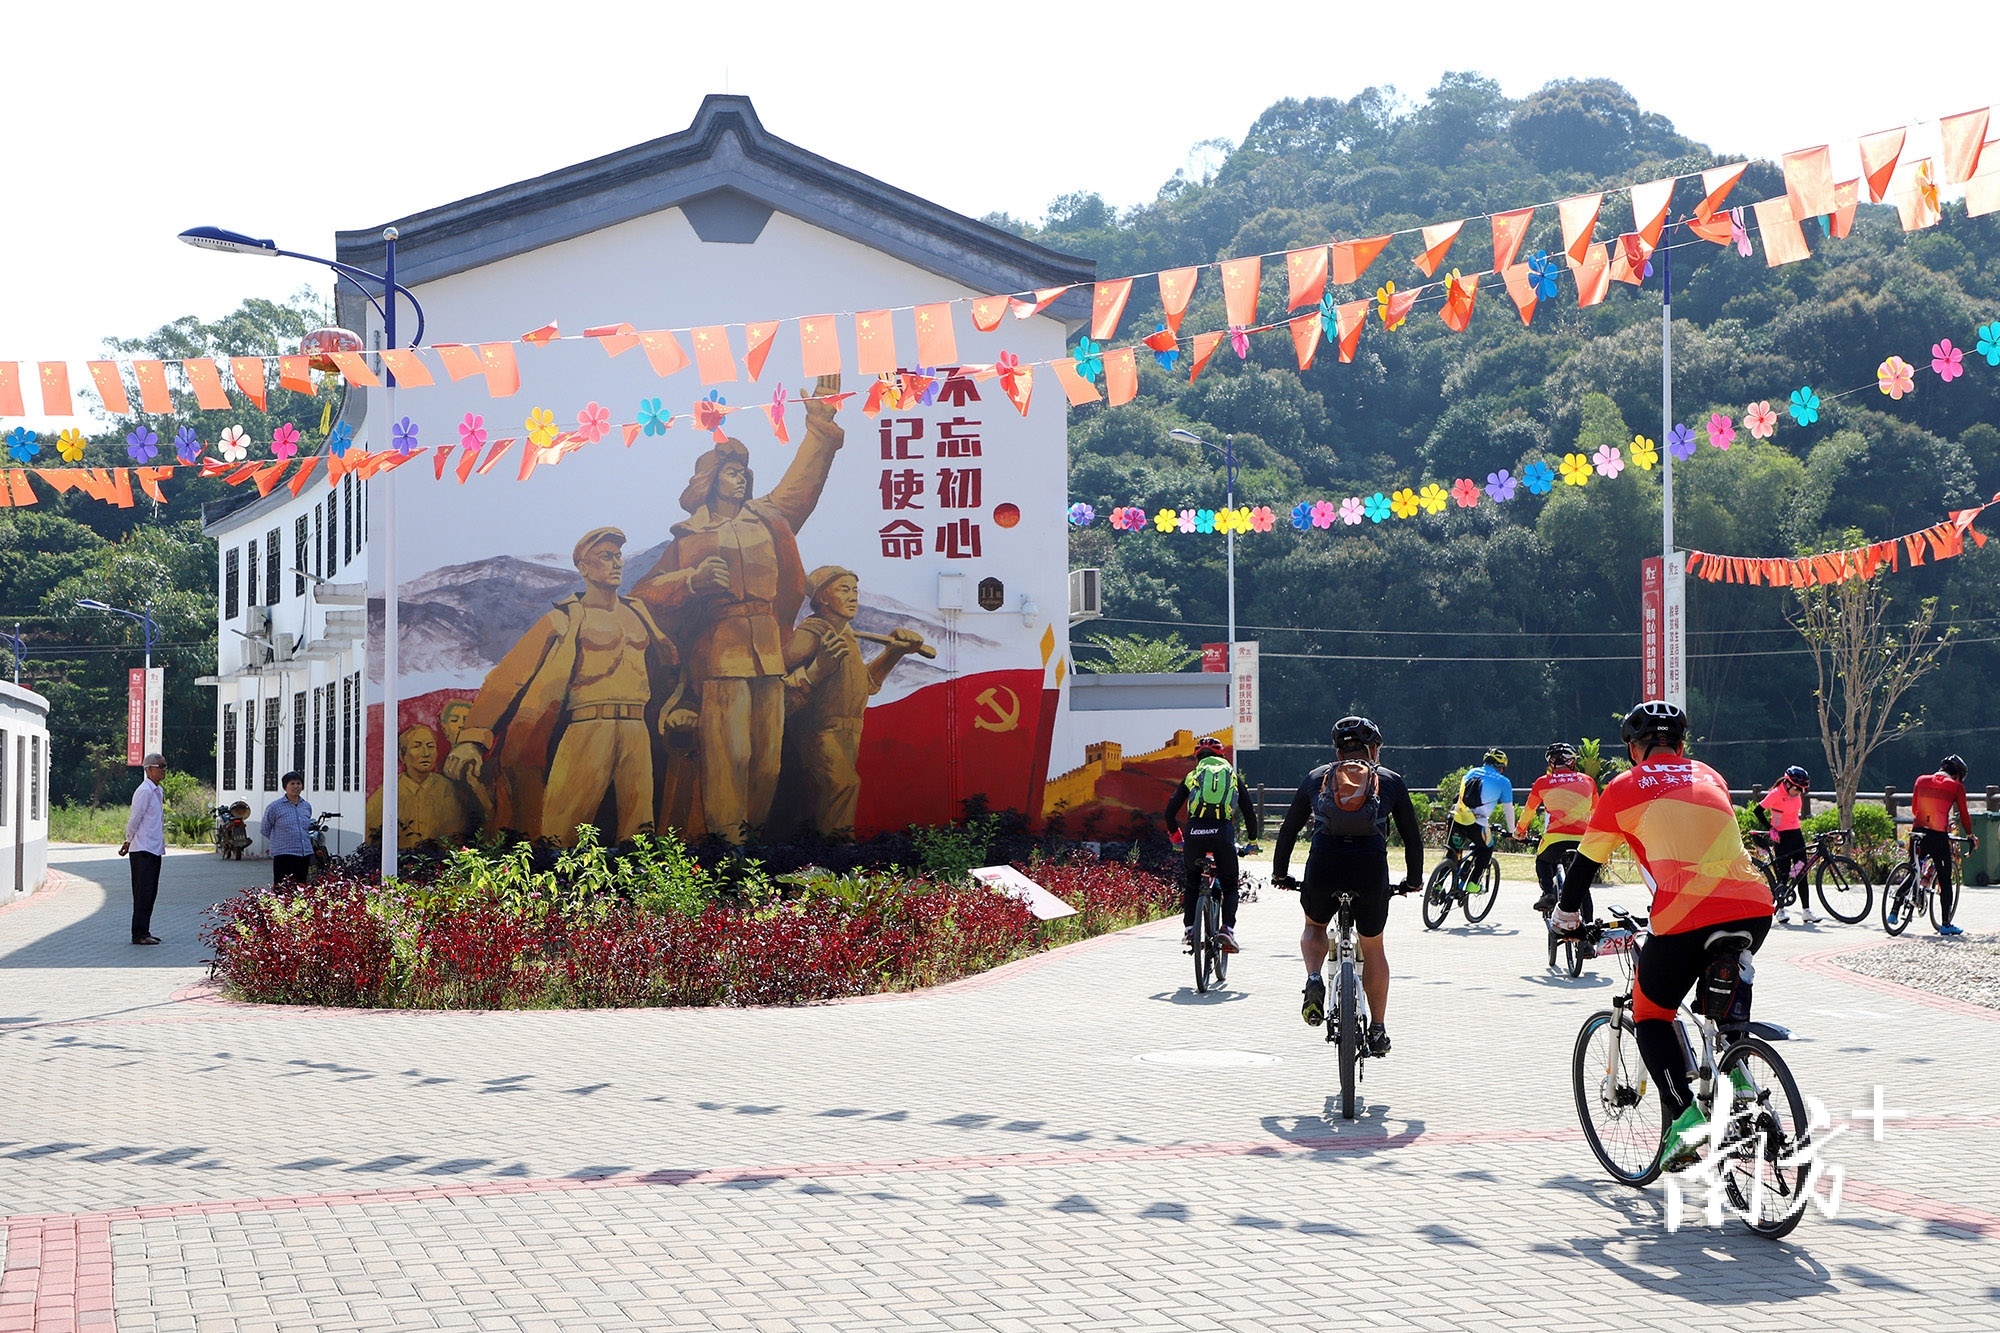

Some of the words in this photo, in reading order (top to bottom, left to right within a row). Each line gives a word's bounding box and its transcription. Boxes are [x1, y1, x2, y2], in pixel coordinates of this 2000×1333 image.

[878, 367, 925, 560] 记使命
[935, 367, 983, 559] 不忘初心
[1641, 763, 1701, 773] UCC
